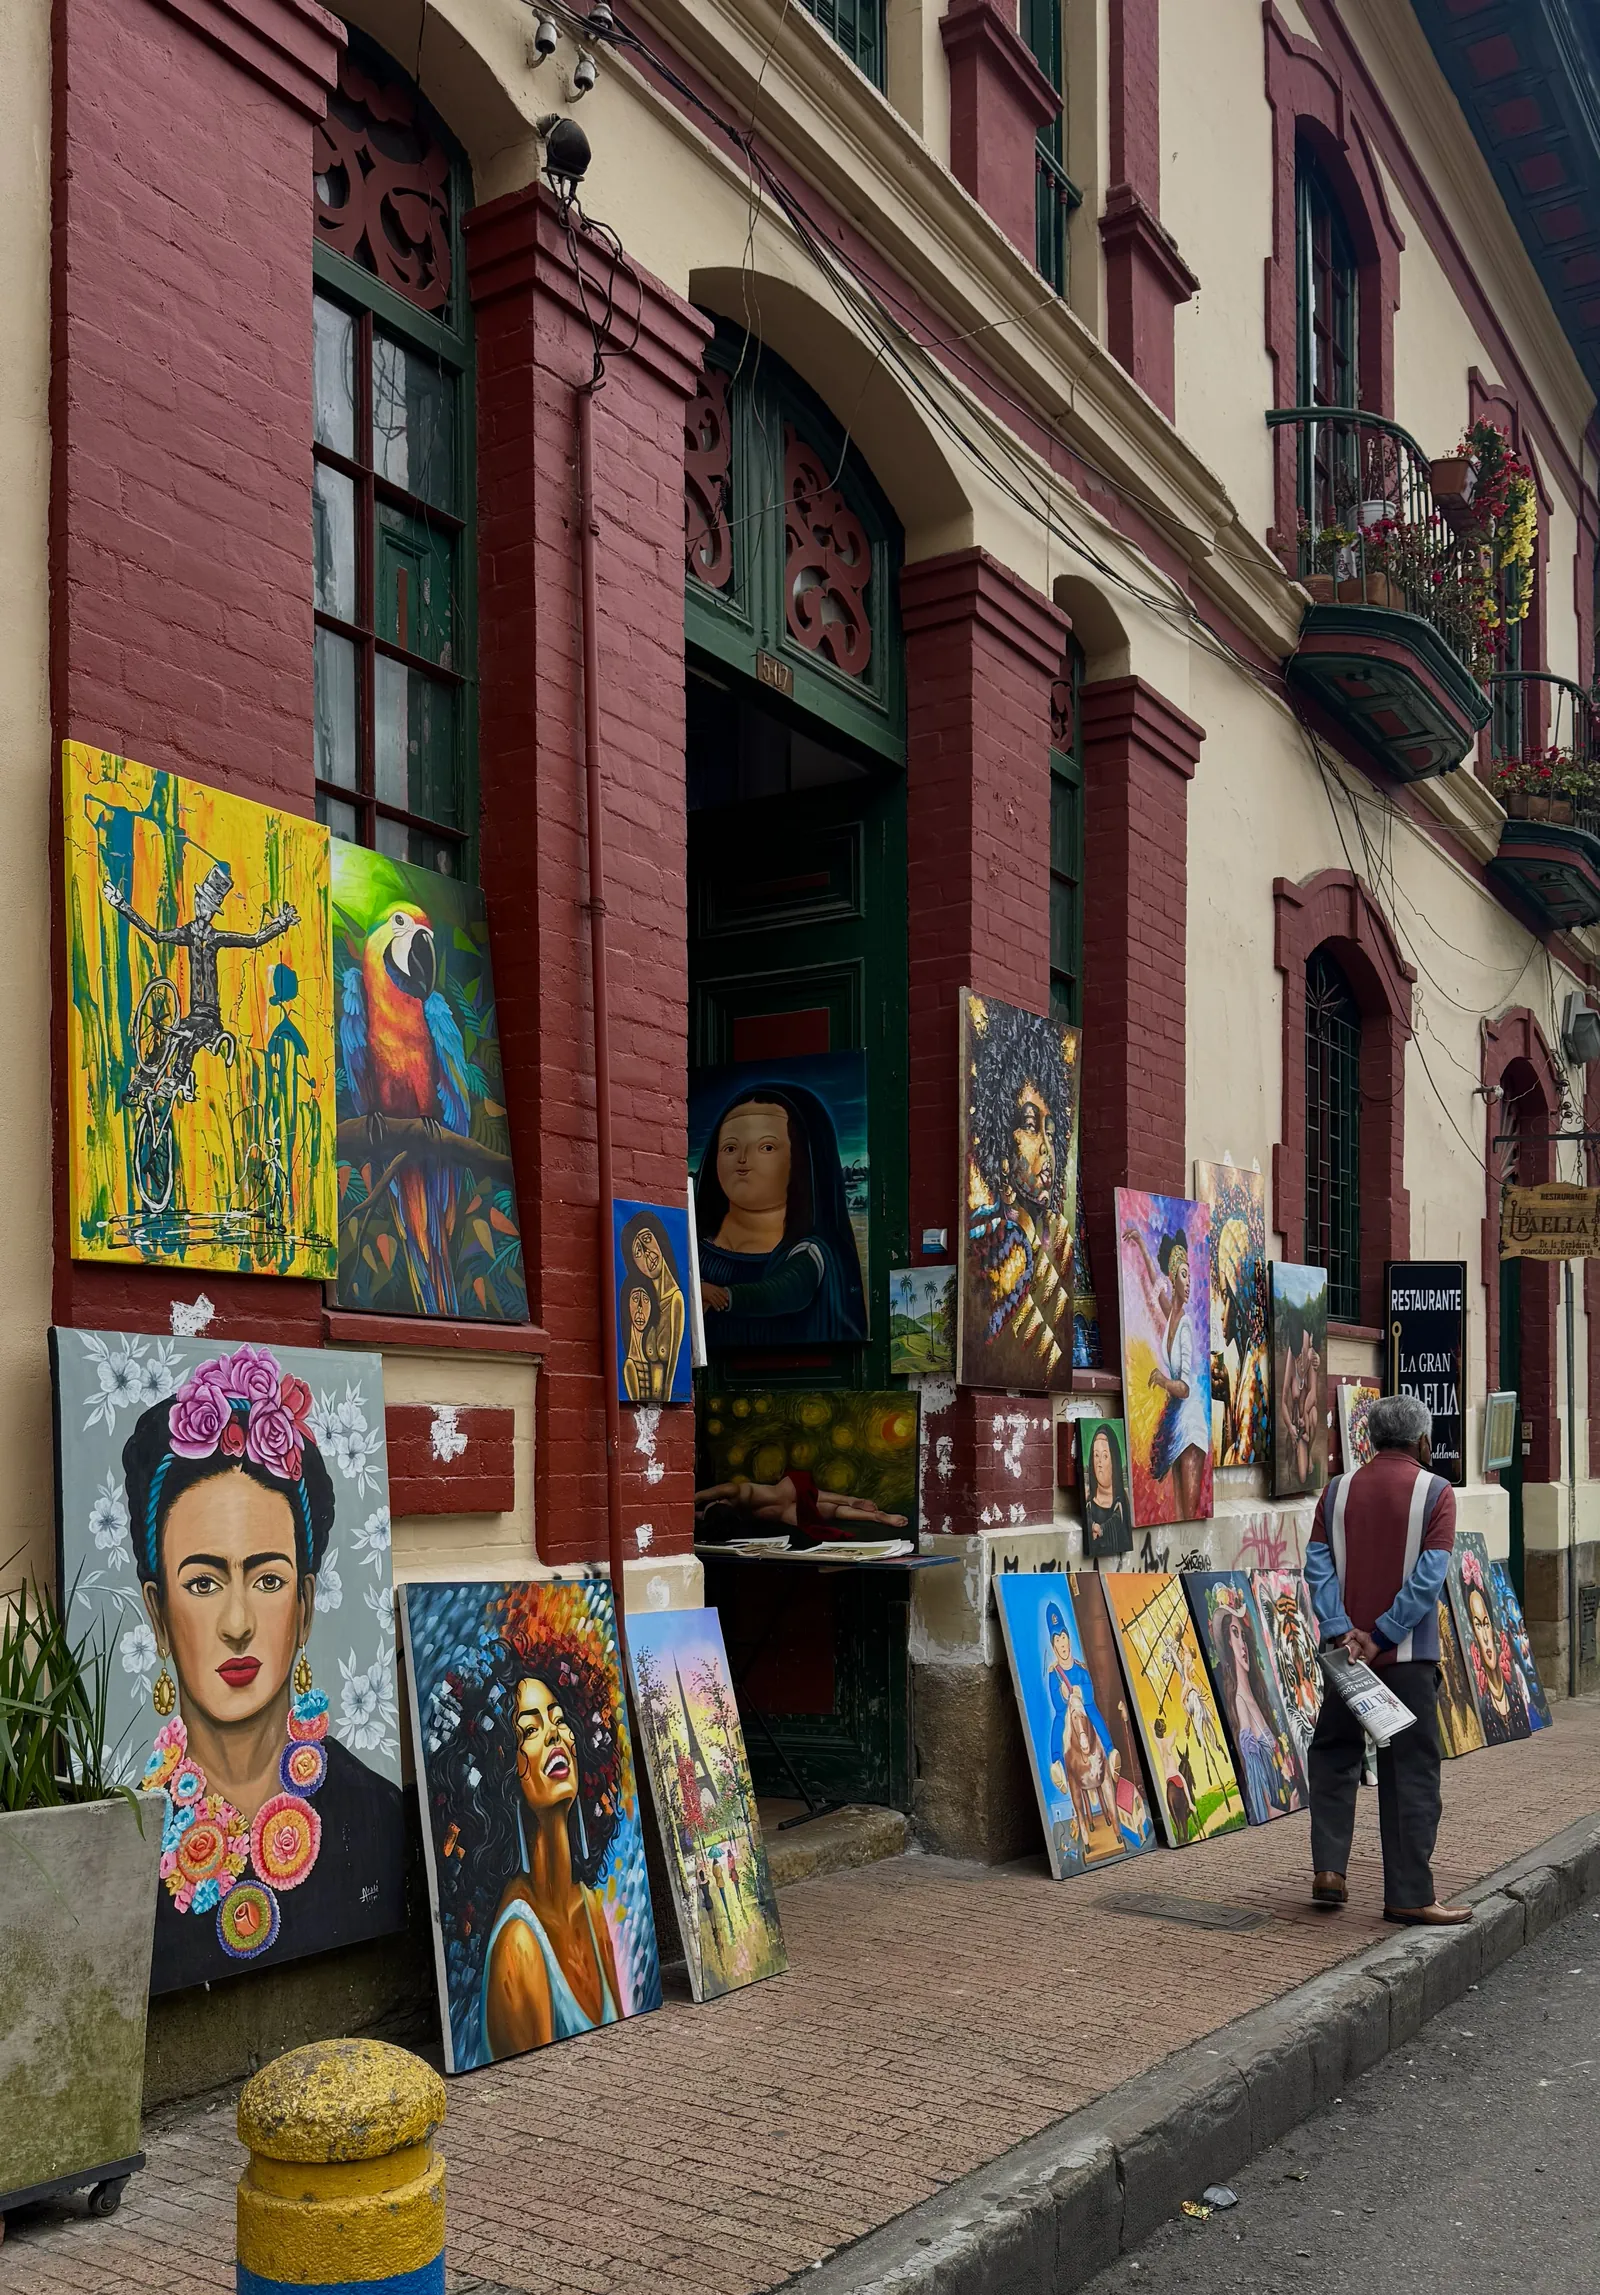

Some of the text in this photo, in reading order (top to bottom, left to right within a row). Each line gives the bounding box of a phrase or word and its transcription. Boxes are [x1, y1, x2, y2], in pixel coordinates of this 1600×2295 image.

[1518, 1207, 1533, 1215] LA
[1391, 1289, 1462, 1311] RESTAURANTE
[1400, 1353, 1451, 1373] LA GRAN
